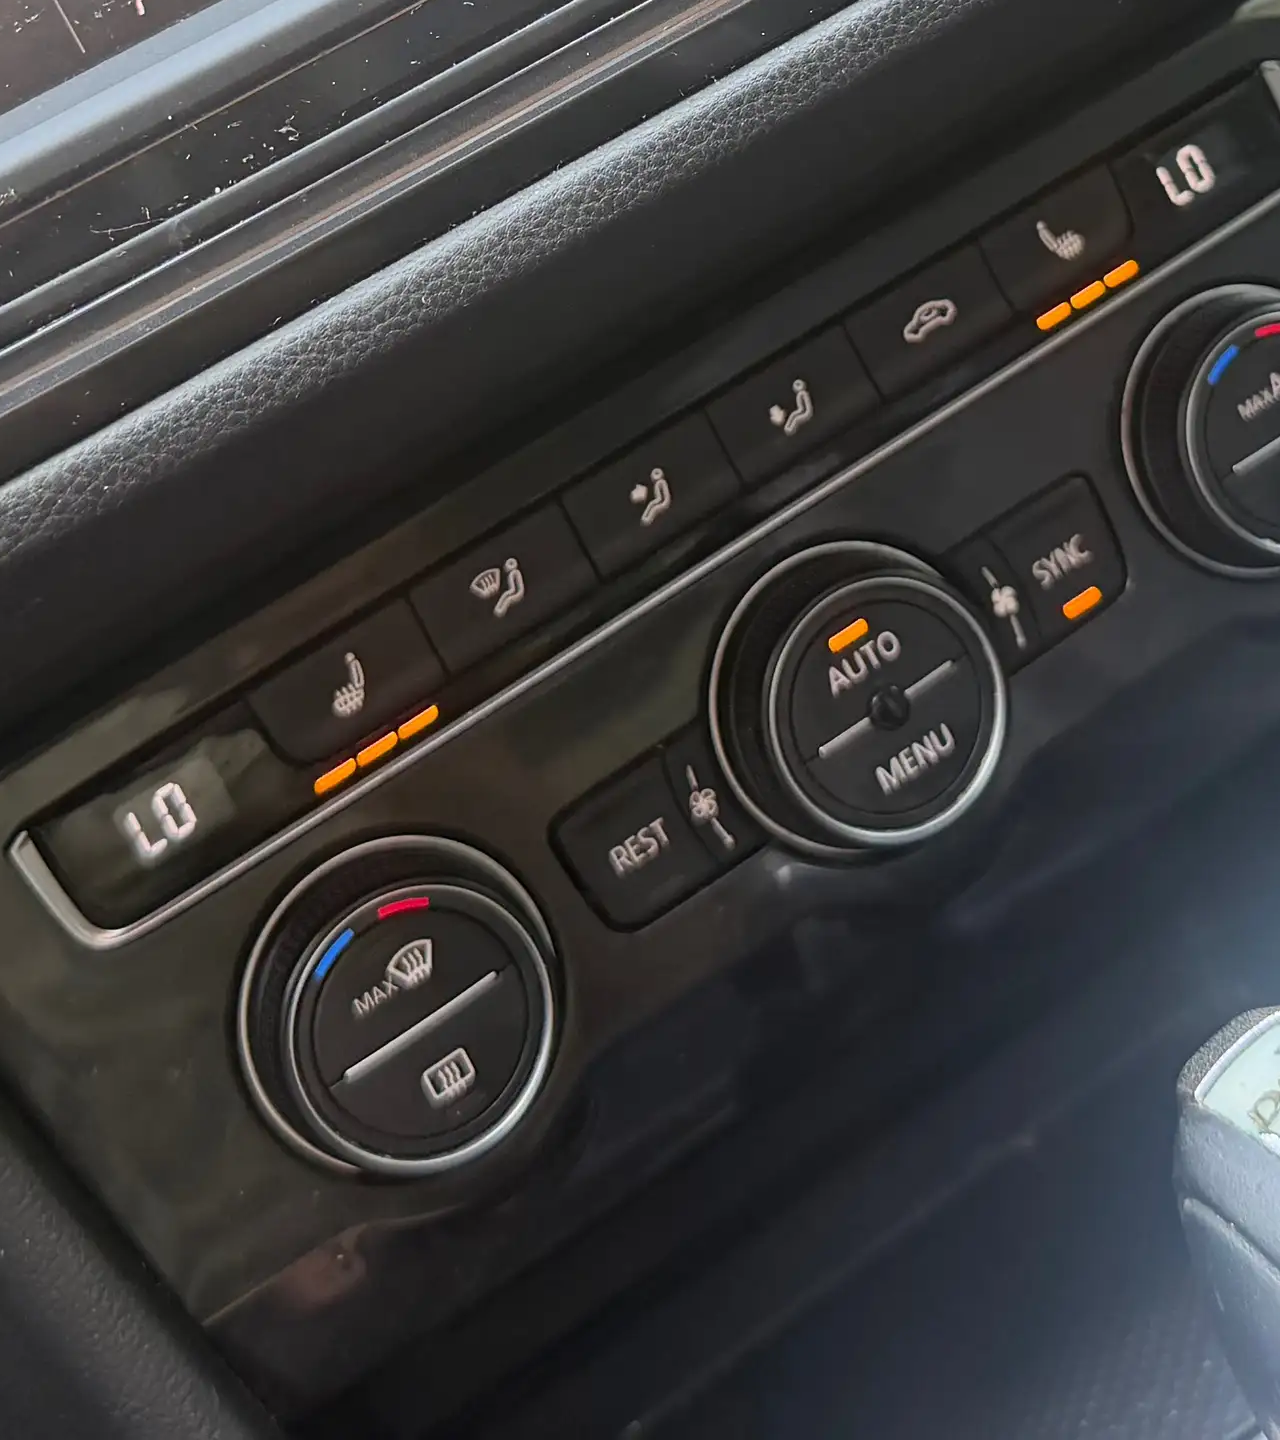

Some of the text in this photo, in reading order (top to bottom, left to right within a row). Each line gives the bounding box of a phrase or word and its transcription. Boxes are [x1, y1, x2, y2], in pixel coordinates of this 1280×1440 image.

[1154, 143, 1217, 208] LO
[1032, 532, 1095, 592] SYNC
[827, 628, 903, 698] AUTO
[872, 721, 958, 797] MENU
[122, 780, 198, 859] LO
[607, 815, 670, 876] REST
[352, 973, 399, 1018] MAX
